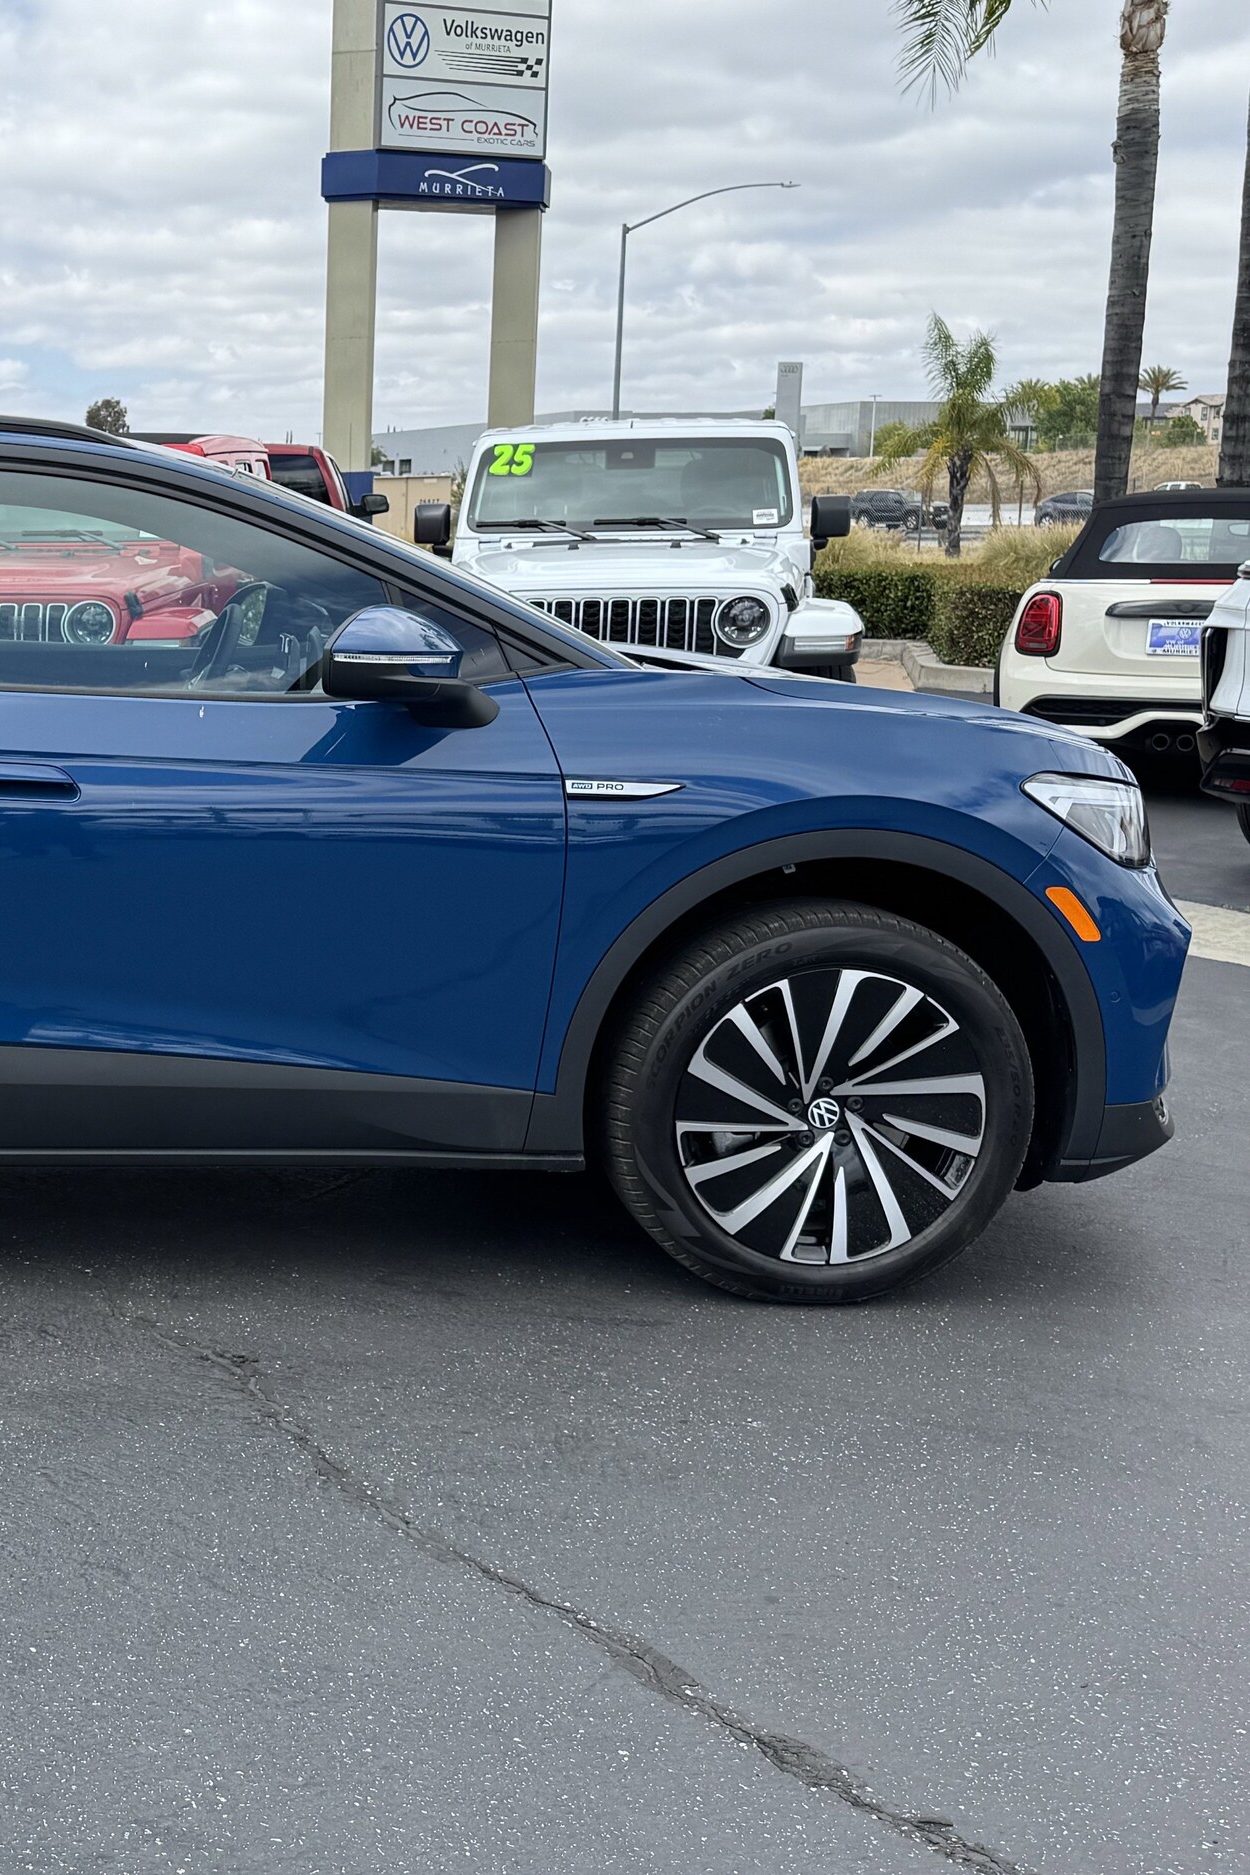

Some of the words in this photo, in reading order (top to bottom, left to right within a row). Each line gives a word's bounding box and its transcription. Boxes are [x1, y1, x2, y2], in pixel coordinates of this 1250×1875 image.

[443, 18, 545, 47] Volkswagen
[465, 42, 473, 51] of
[475, 43, 512, 54] MURRIETA
[398, 114, 455, 133] WEST
[461, 119, 529, 138] COAST
[477, 137, 508, 146] EXOTIC
[510, 139, 535, 148] CARS
[419, 181, 505, 197] MURRIETA
[489, 444, 535, 476] 25
[597, 783, 624, 791] PRO
[646, 980, 718, 1090] SCORPION
[726, 942, 792, 981] ZERO
